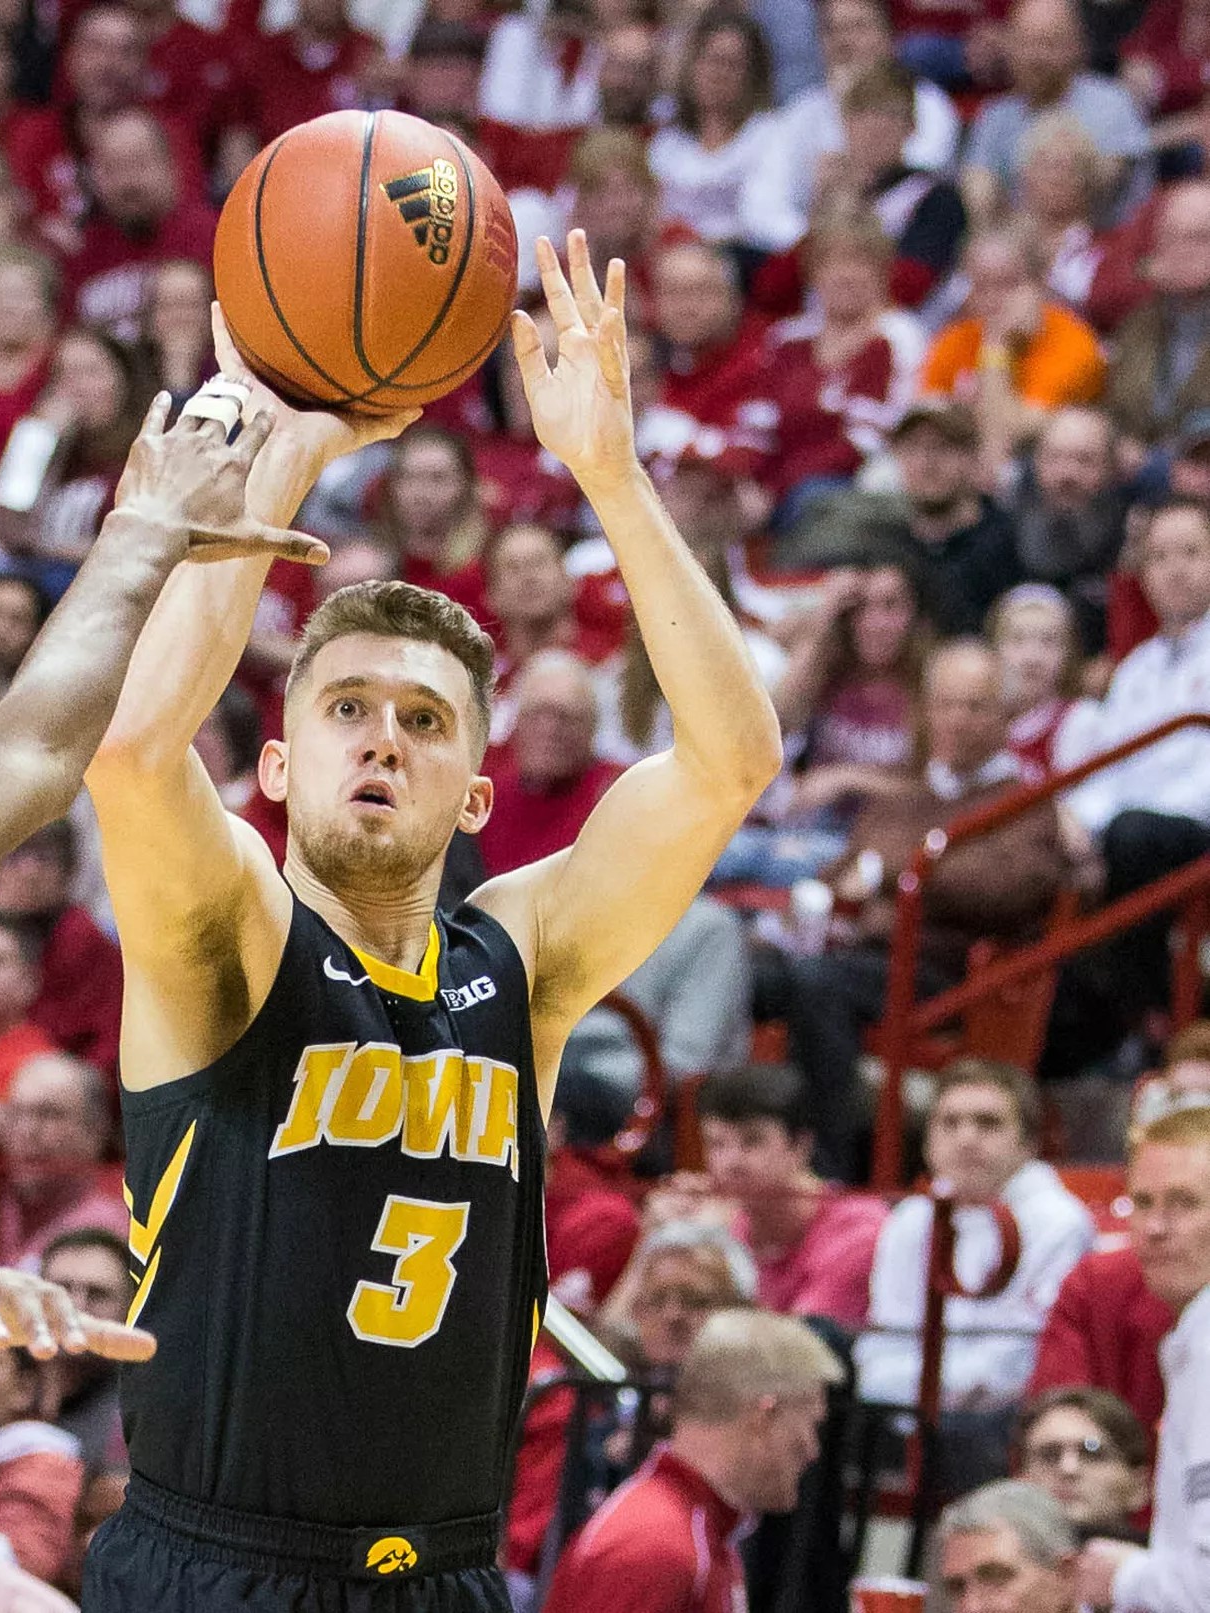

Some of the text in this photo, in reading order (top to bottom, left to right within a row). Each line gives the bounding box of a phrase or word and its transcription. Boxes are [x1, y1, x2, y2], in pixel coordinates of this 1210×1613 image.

[428, 158, 458, 265] adidas
[268, 1040, 520, 1183] IOWA
[346, 1194, 471, 1348] 3
